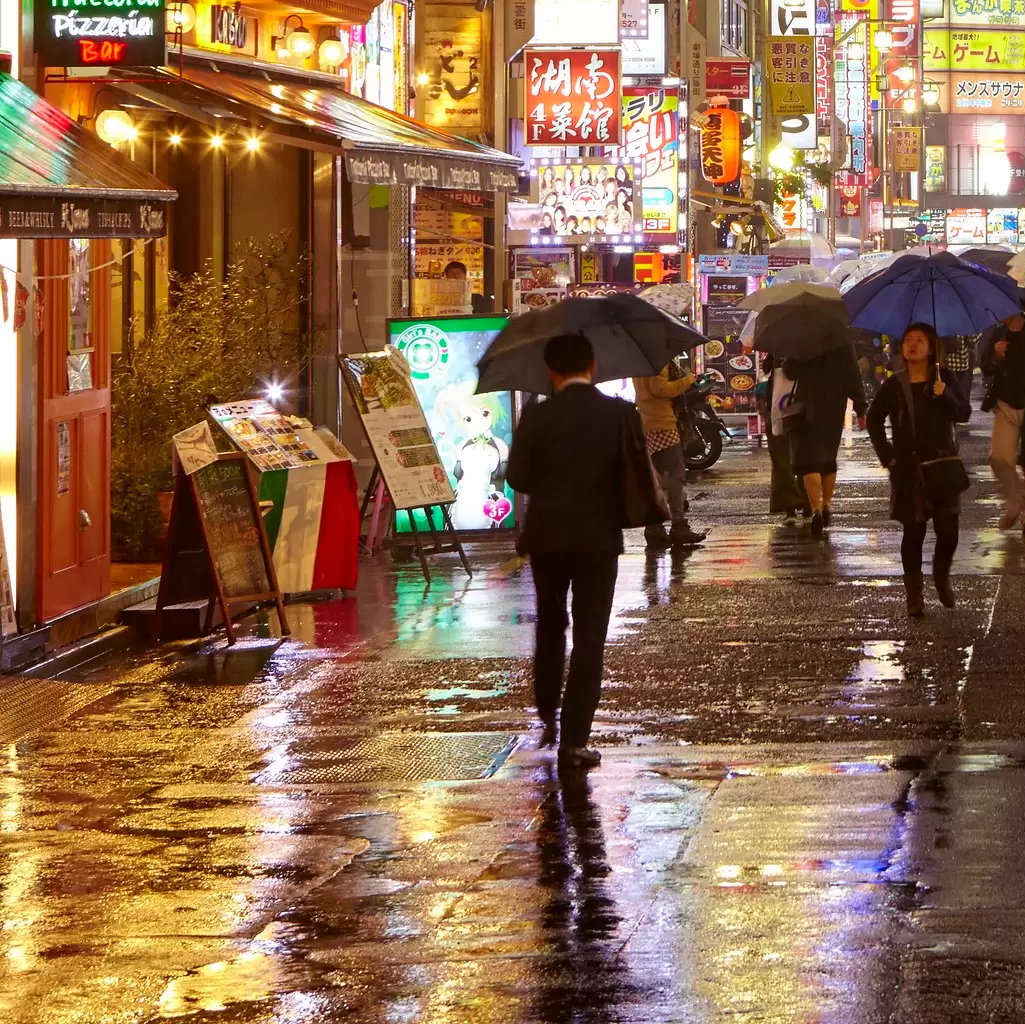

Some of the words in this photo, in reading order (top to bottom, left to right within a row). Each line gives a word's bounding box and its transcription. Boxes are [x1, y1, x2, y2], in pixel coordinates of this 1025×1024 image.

[53, 10, 154, 38] Pizzeria
[80, 40, 126, 63] Bar
[771, 43, 810, 55] 悪質な
[953, 43, 1001, 64] ゲーム
[771, 57, 810, 69] 客引き
[531, 53, 615, 100] 湖南
[772, 70, 811, 83] に注意
[956, 81, 1024, 97] メンズサウナ
[549, 101, 615, 142] 菜館
[488, 505, 507, 519] 3F
